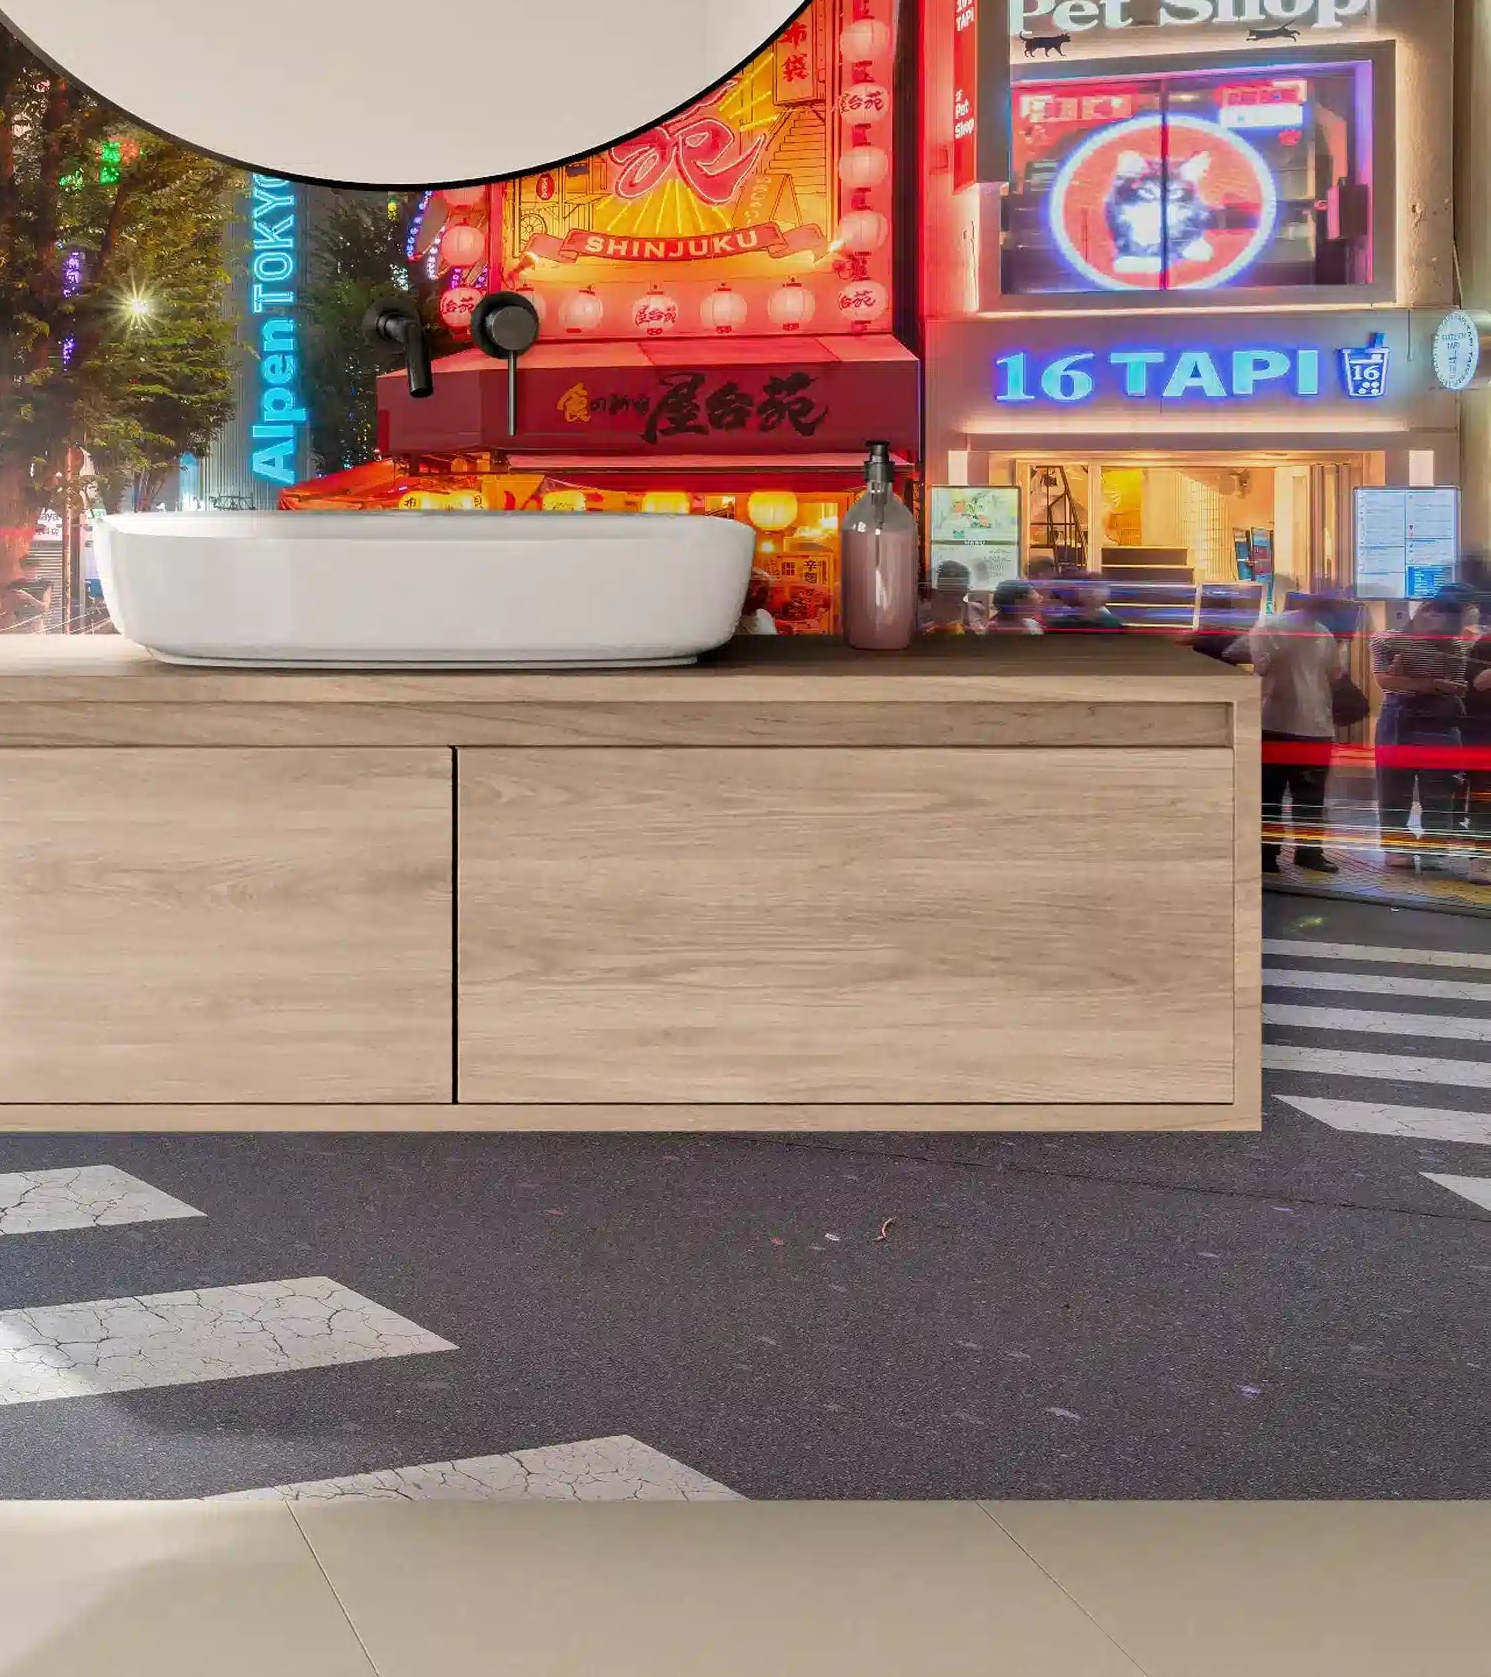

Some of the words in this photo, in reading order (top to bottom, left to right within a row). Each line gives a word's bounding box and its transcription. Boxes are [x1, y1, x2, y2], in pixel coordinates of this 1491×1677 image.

[584, 230, 759, 261] SHINJUKU
[995, 353, 1095, 401] 16
[1110, 349, 1318, 396] TAPI
[1352, 365, 1380, 380] 16
[251, 317, 308, 485] Alpen
